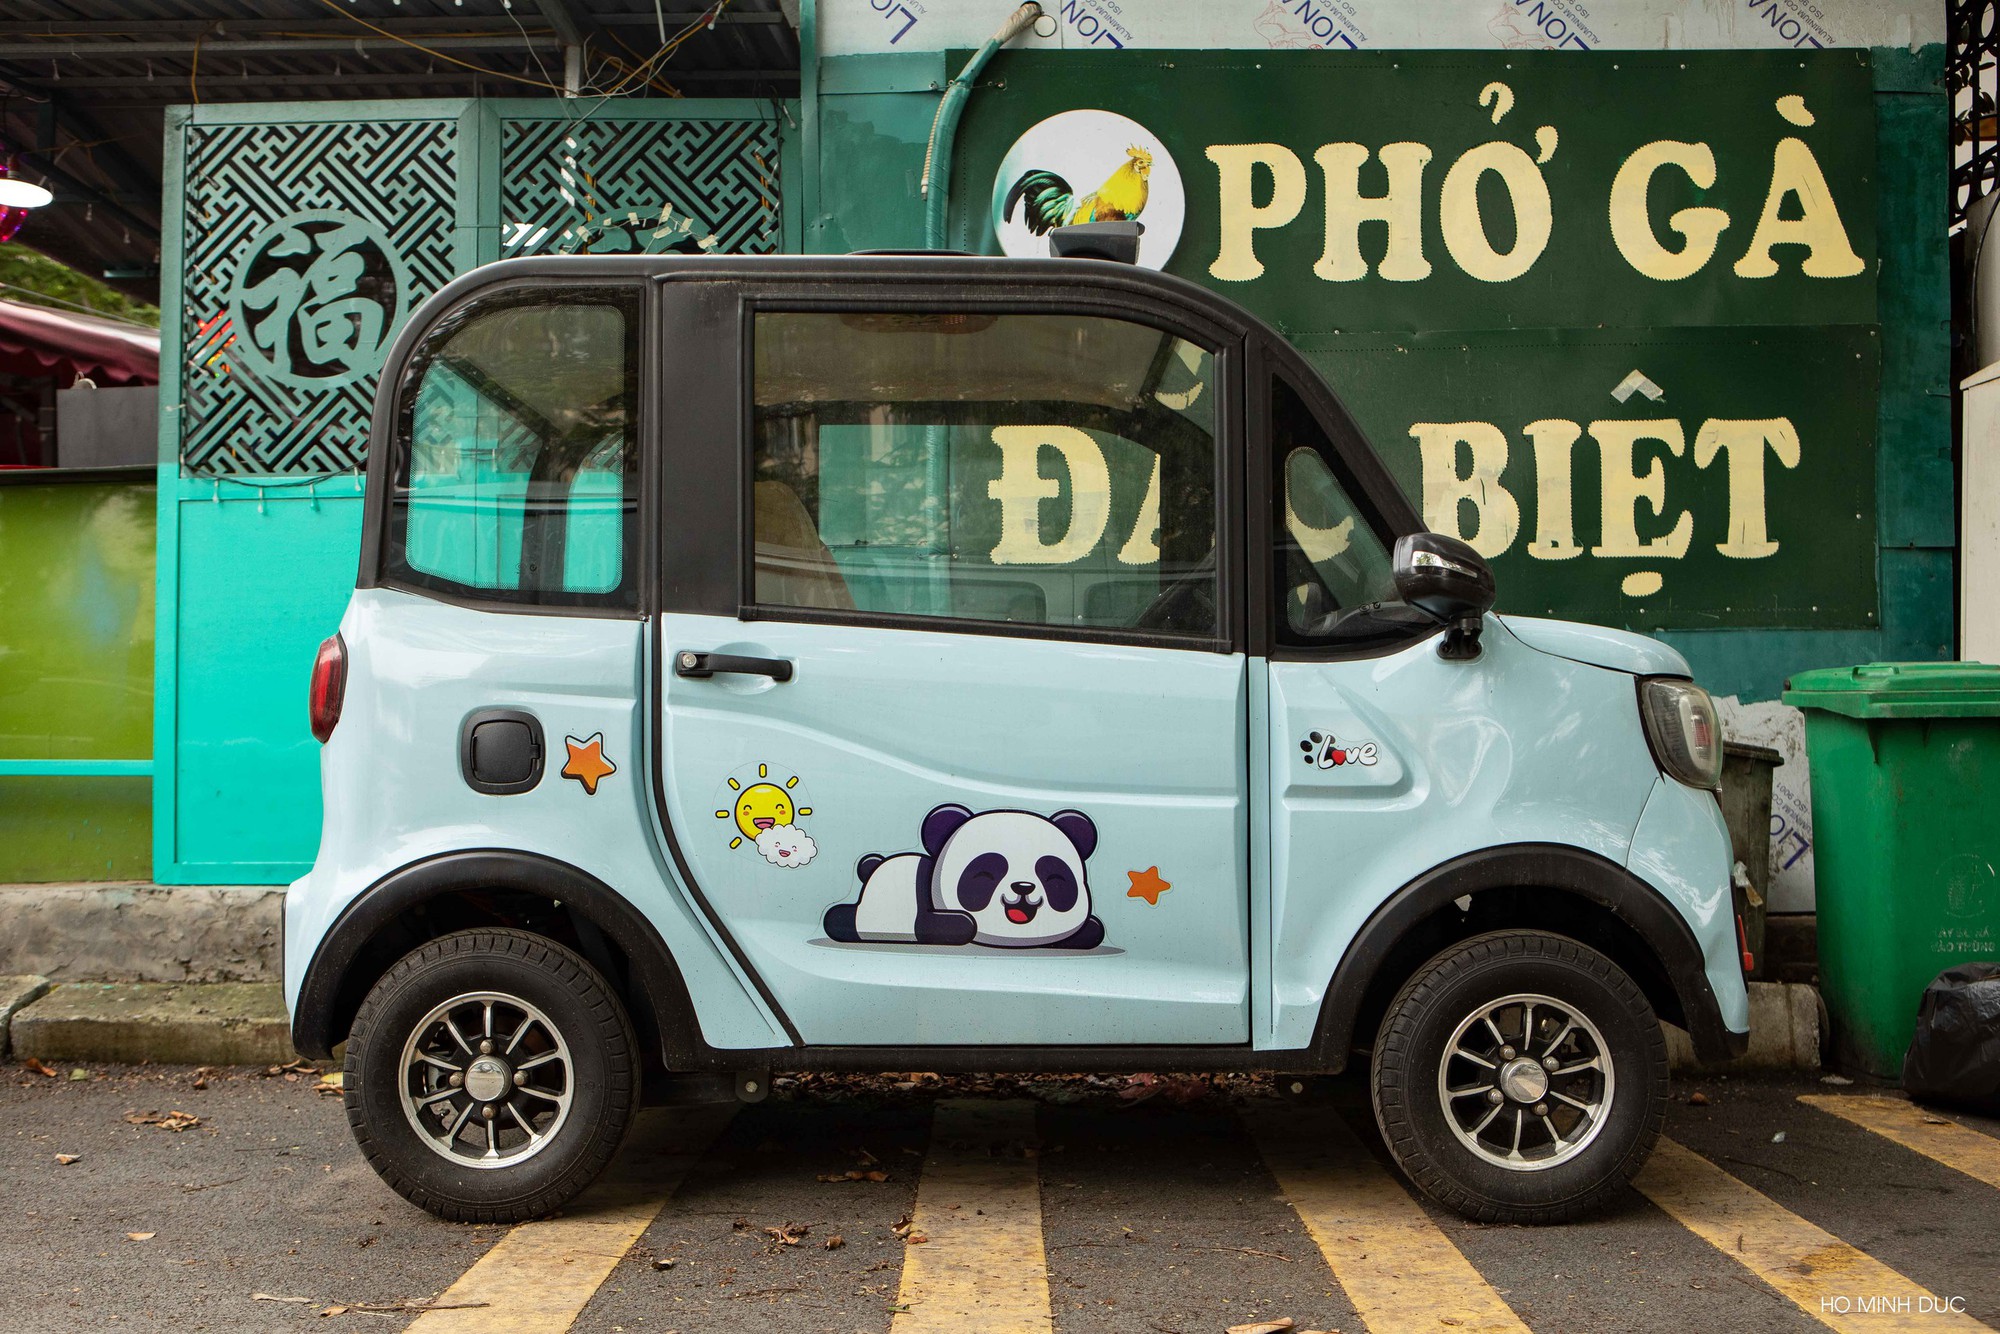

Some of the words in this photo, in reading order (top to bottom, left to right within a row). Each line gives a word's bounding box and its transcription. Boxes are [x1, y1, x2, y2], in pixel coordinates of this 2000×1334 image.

[1095, 6, 1134, 41] ALUMINIUM
[1331, 6, 1369, 42] ALUMINIUM
[1562, 8, 1601, 44] ALUMINIUM
[1761, 2, 1825, 49] ION
[1797, 9, 1837, 45] ALUMINIUM
[1808, 5, 1825, 20] ISO
[1204, 82, 1556, 283] PHỞ
[1609, 94, 1866, 282] GÀ
[240, 224, 384, 379] 福
[1408, 369, 1800, 598] BIỆT
[1776, 782, 1795, 800] 9001
